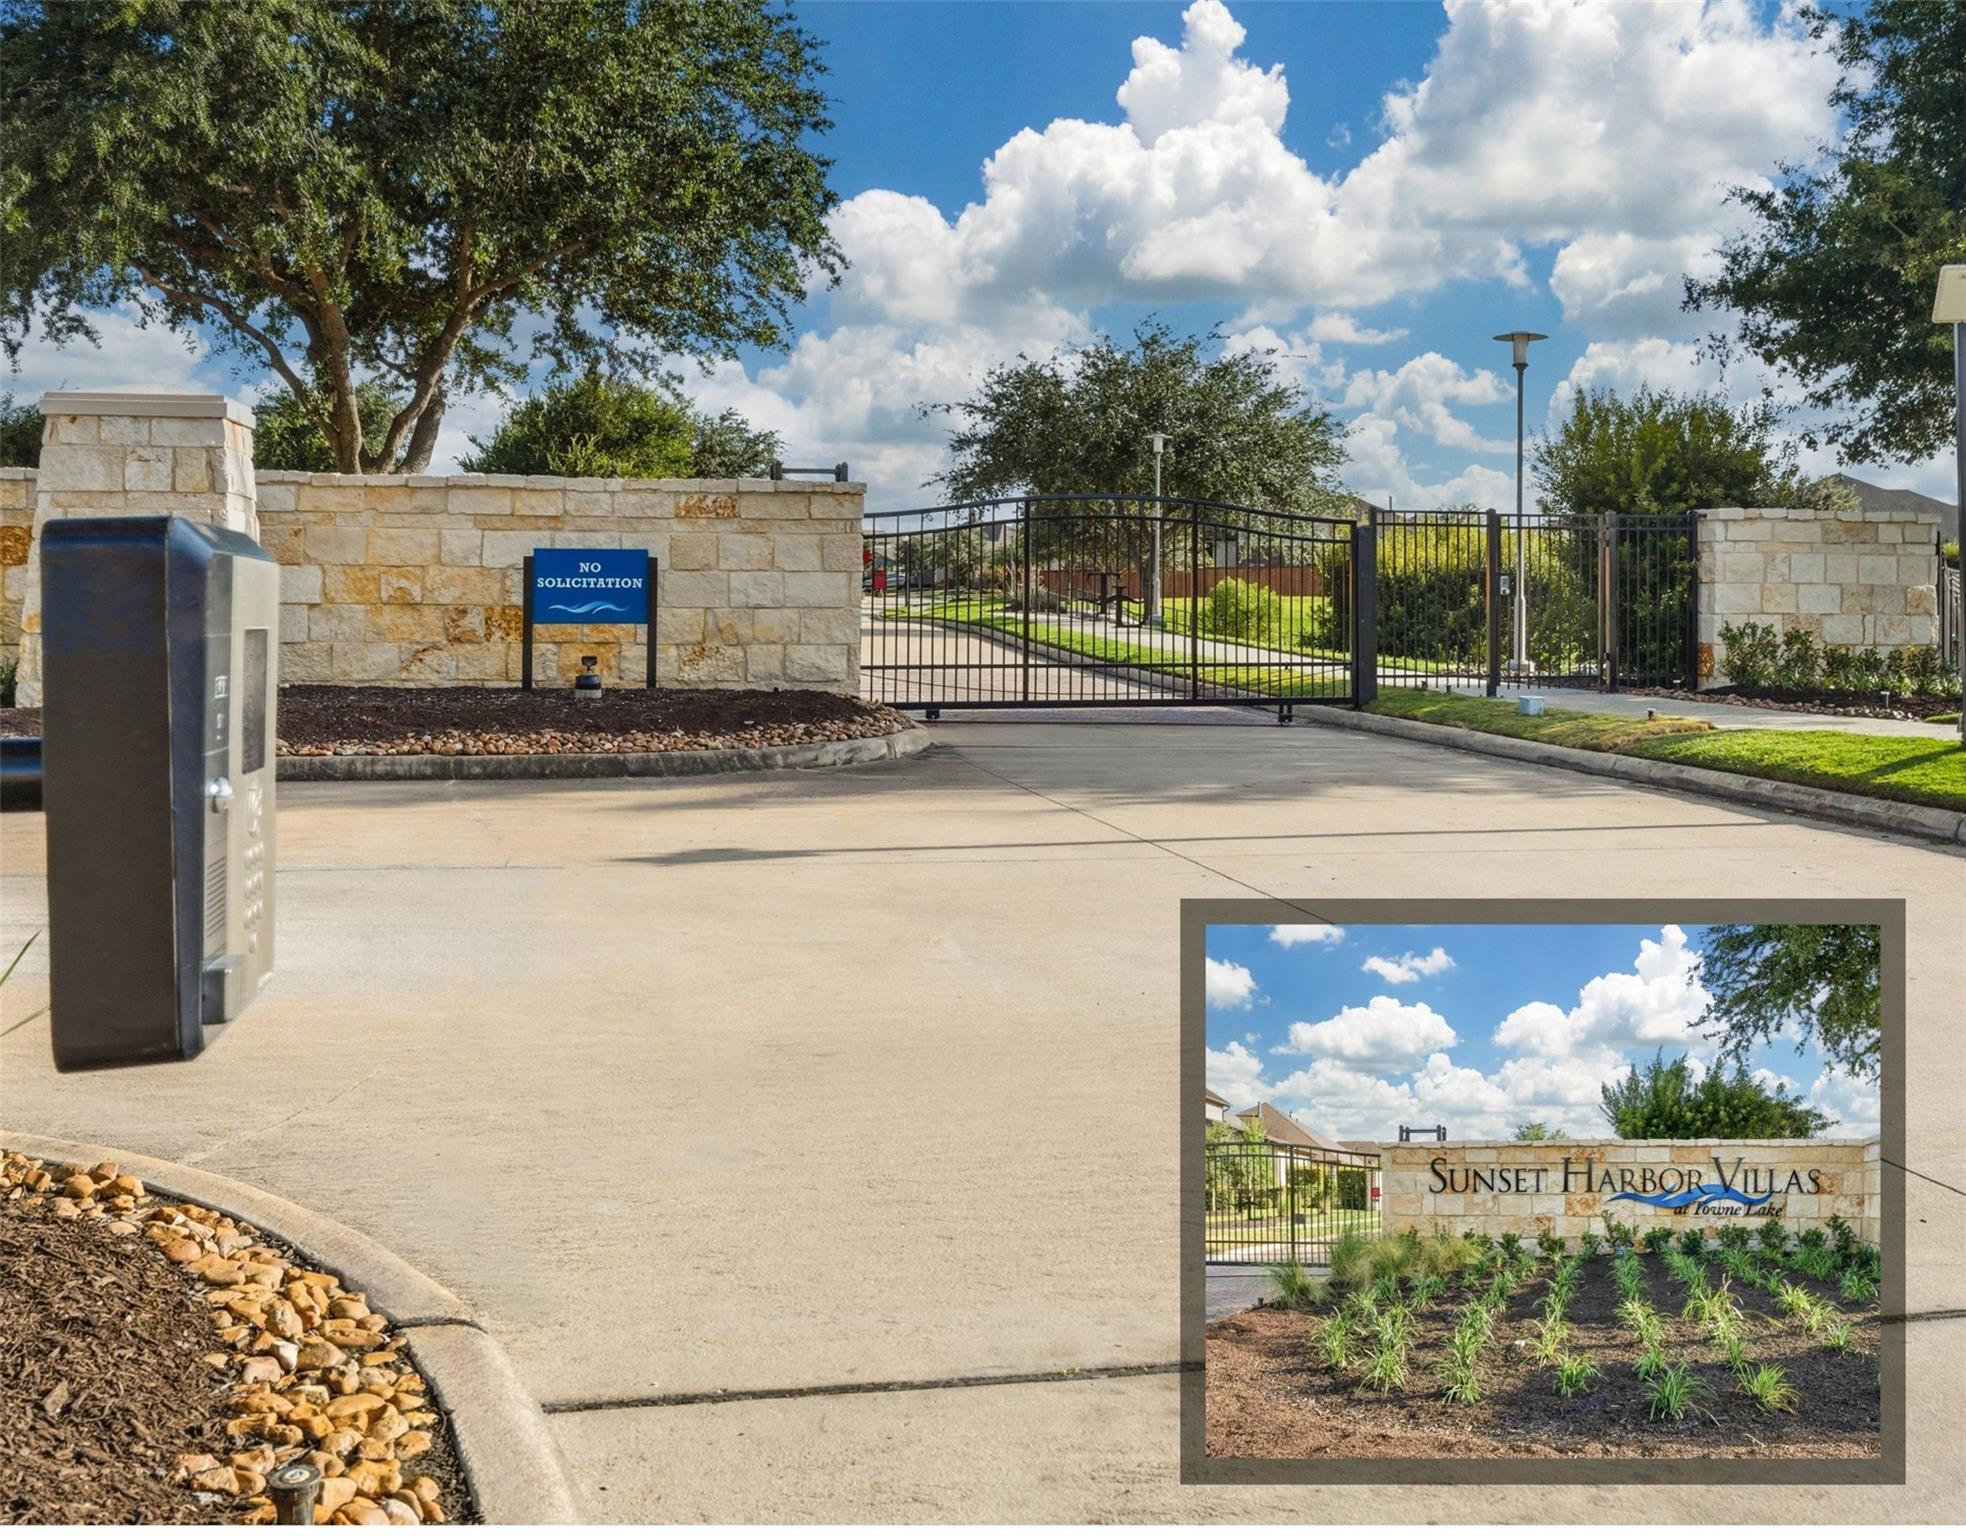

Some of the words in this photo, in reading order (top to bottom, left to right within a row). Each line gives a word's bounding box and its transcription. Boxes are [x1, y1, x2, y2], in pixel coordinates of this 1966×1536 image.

[579, 562, 601, 573] NO
[537, 577, 644, 589] SOLICITATION
[1429, 1157, 1548, 1194] SUNSET
[1561, 1157, 1711, 1194] HARBOR
[1712, 1157, 1822, 1194] VILLAS
[1673, 1204, 1688, 1215] at
[1694, 1201, 1740, 1216] Towne
[1745, 1202, 1783, 1217] Lake
